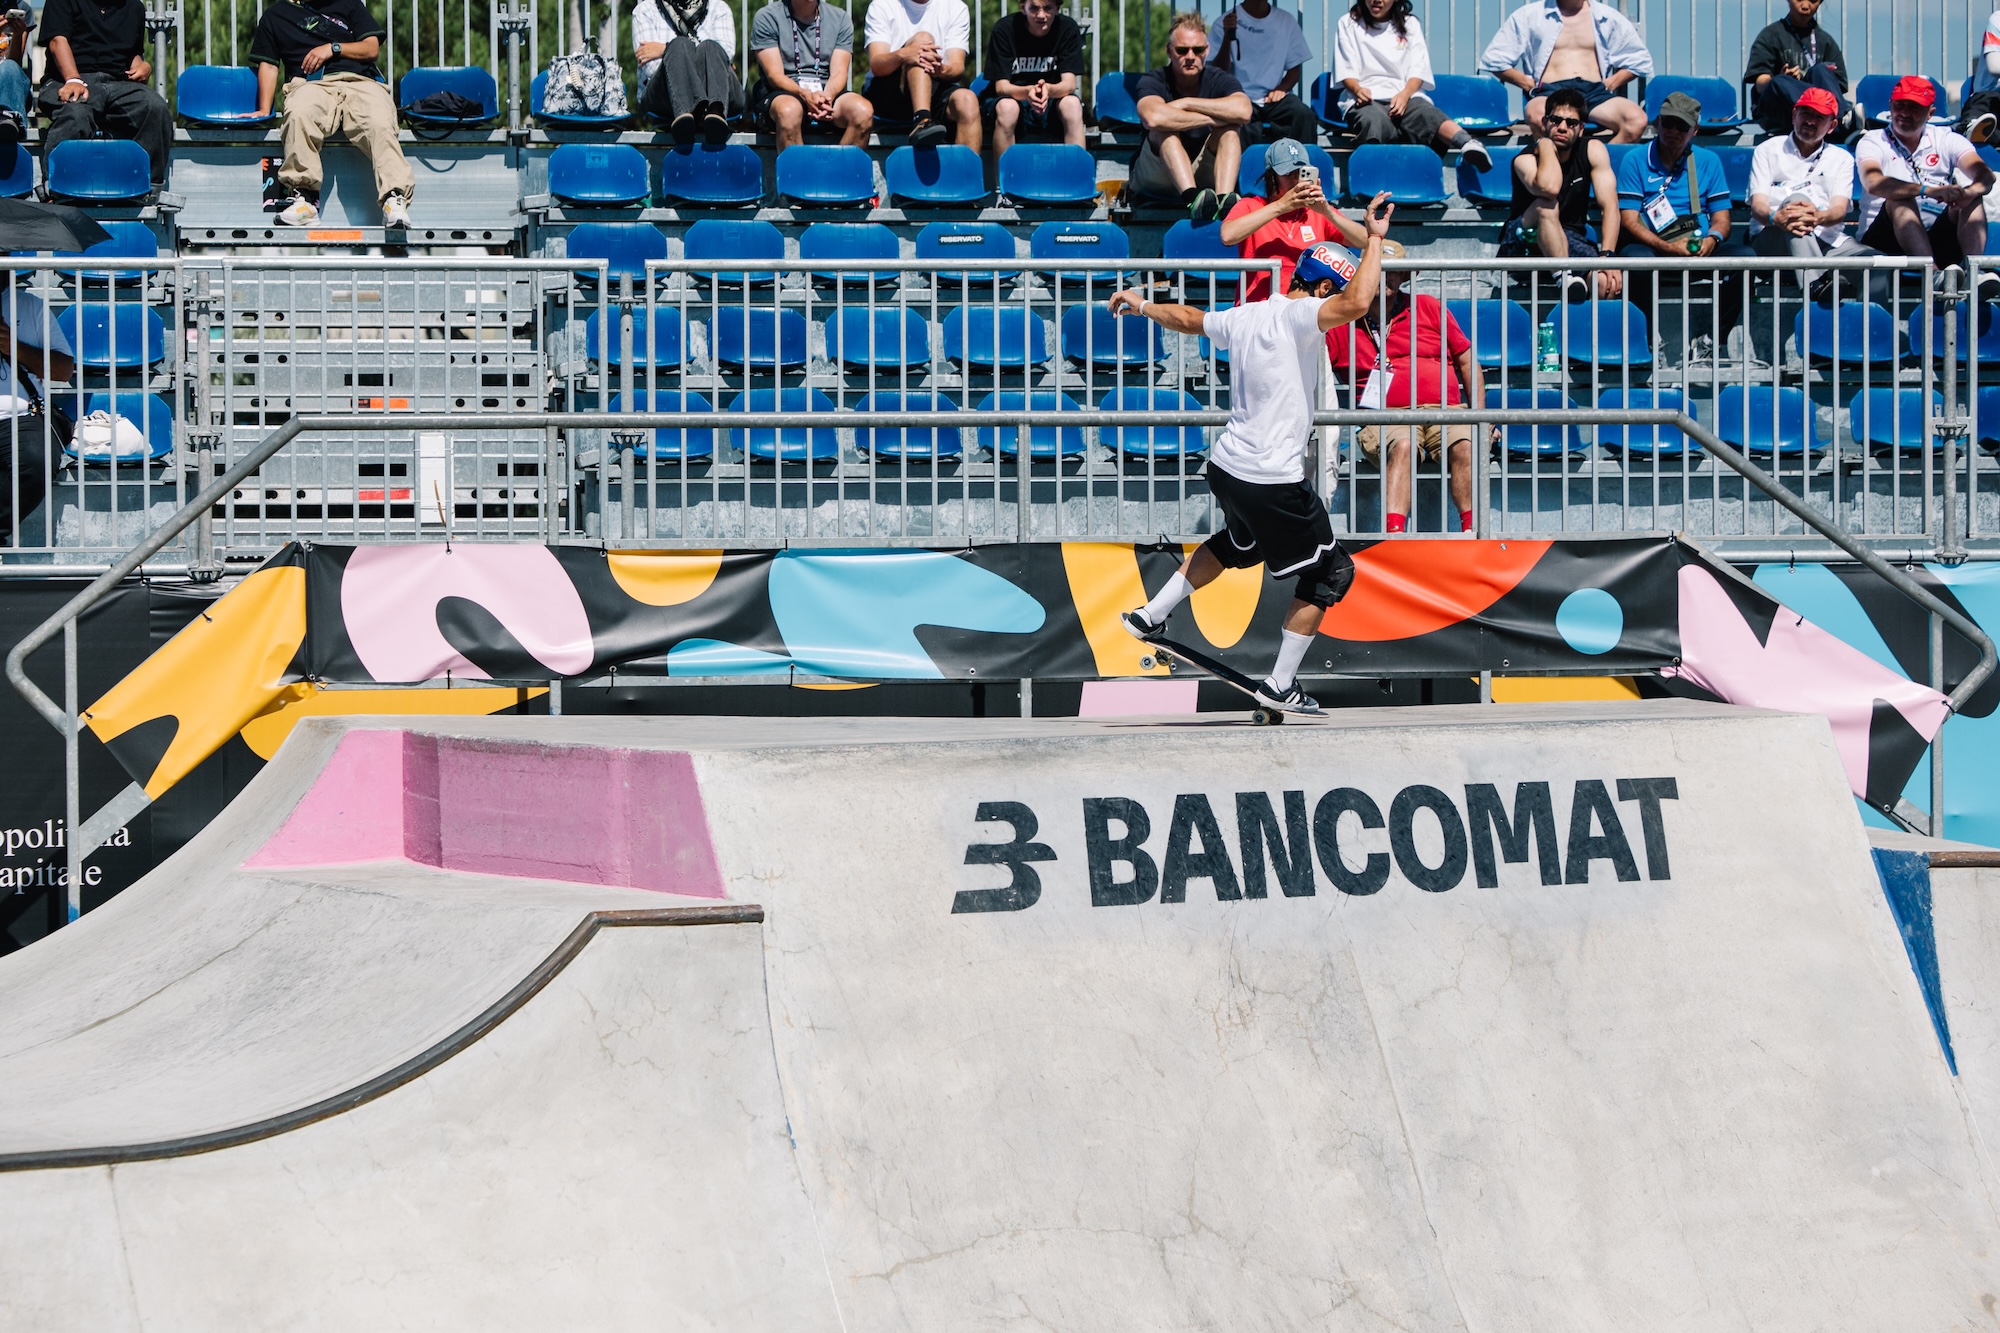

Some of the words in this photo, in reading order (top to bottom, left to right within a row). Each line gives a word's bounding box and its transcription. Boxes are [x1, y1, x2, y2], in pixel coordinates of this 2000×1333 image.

[940, 235, 982, 243] RISERVATO
[1056, 235, 1098, 243] RISERVATO
[1083, 777, 1680, 908] BANCOMAT
